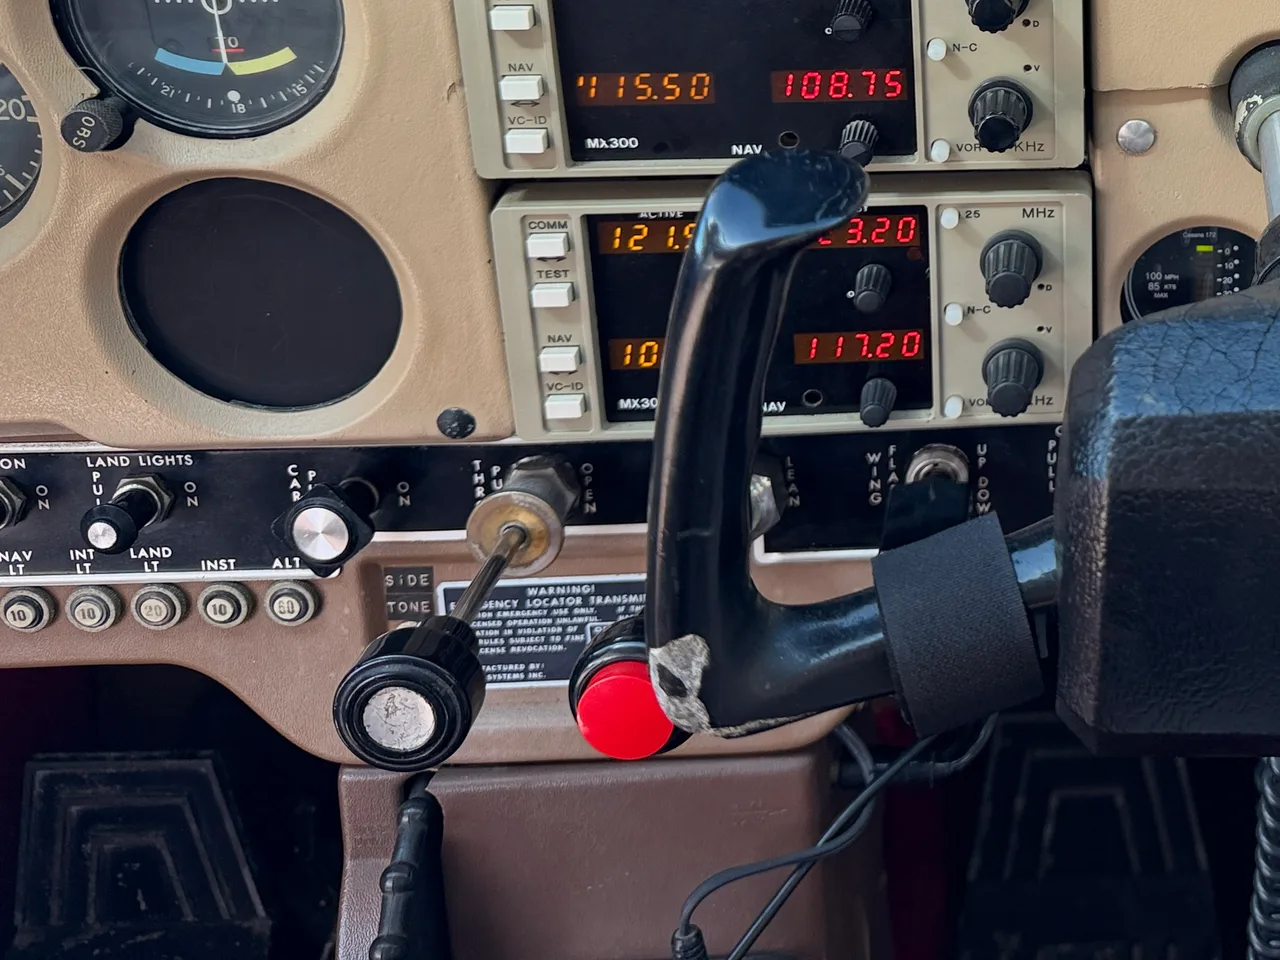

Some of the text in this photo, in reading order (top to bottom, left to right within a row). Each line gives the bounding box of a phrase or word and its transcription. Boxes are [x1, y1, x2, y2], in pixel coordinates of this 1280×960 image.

[952, 43, 978, 53] N-C
[508, 63, 534, 72] NAV
[785, 69, 903, 100] 108.75
[231, 102, 246, 114] 18
[508, 115, 547, 125] VC-ID
[73, 116, 96, 149] OBS
[585, 137, 639, 149] MX300
[1014, 142, 1045, 152] KHz
[731, 144, 763, 155] NAV
[965, 210, 981, 219] 25
[1022, 207, 1056, 219] MHz
[528, 220, 568, 230] COMM
[537, 269, 570, 279] TEST
[1145, 272, 1162, 280] 100
[1148, 282, 1160, 291] 85
[967, 305, 991, 314] N-C
[548, 334, 572, 343] NAV
[809, 331, 921, 360] 117.20
[545, 381, 584, 391] VC-ID
[86, 455, 193, 467] LAND LIGHTS
[785, 456, 800, 507] LEAN
[867, 451, 883, 505] WING
[581, 462, 597, 513] OPEN
[35, 485, 50, 510] ON
[184, 482, 199, 507] ON
[396, 481, 411, 507] ON
[70, 549, 95, 560] INT
[130, 547, 173, 559] LAND
[9, 564, 25, 575] LT
[76, 563, 92, 574] LT
[144, 561, 160, 572] LT
[201, 559, 236, 571] INST
[527, 584, 596, 596] WARNING!
[278, 599, 296, 615] 60
[387, 601, 431, 613] TONE
[525, 597, 583, 608] LOCATOR
[80, 607, 96, 620] 10
[144, 605, 162, 617] 20
[211, 603, 227, 616] 10
[496, 609, 548, 617] EMERGENCY
[10, 609, 27, 622] 10
[507, 618, 553, 626] OPERATION
[510, 645, 567, 653] REVOCATION.
[486, 673, 525, 681] SYSTEMS
